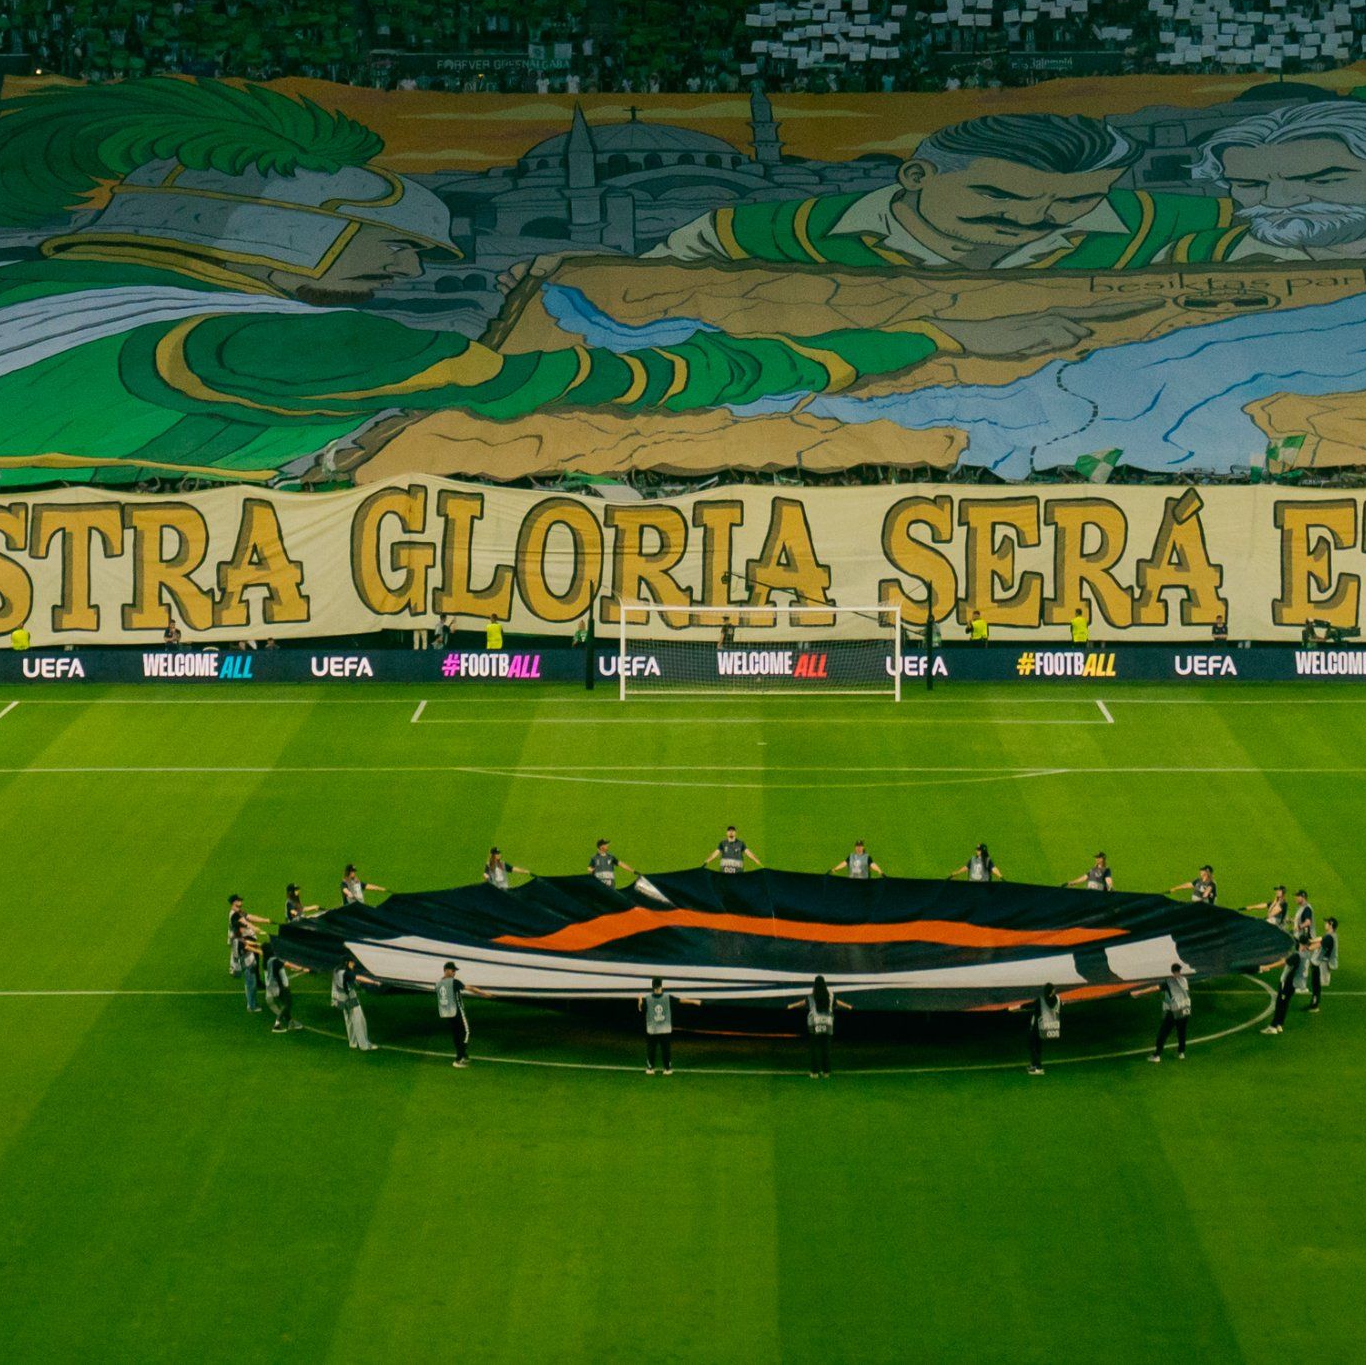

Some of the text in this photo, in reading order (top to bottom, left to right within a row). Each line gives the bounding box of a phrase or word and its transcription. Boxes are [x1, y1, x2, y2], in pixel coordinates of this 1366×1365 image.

[350, 484, 837, 630] GLORIA
[878, 487, 1228, 629] SERÁ
[22, 657, 85, 678] UEFA
[142, 653, 253, 679] WELCOME ALL
[311, 656, 374, 677] UEFA
[441, 653, 541, 678] #FOOTBALL
[599, 656, 661, 676] UEFA
[717, 651, 828, 678] WELCOME ALL
[885, 655, 948, 676] UEFA
[1016, 652, 1116, 677] #FOOTBALL
[1174, 655, 1238, 676] UEFA
